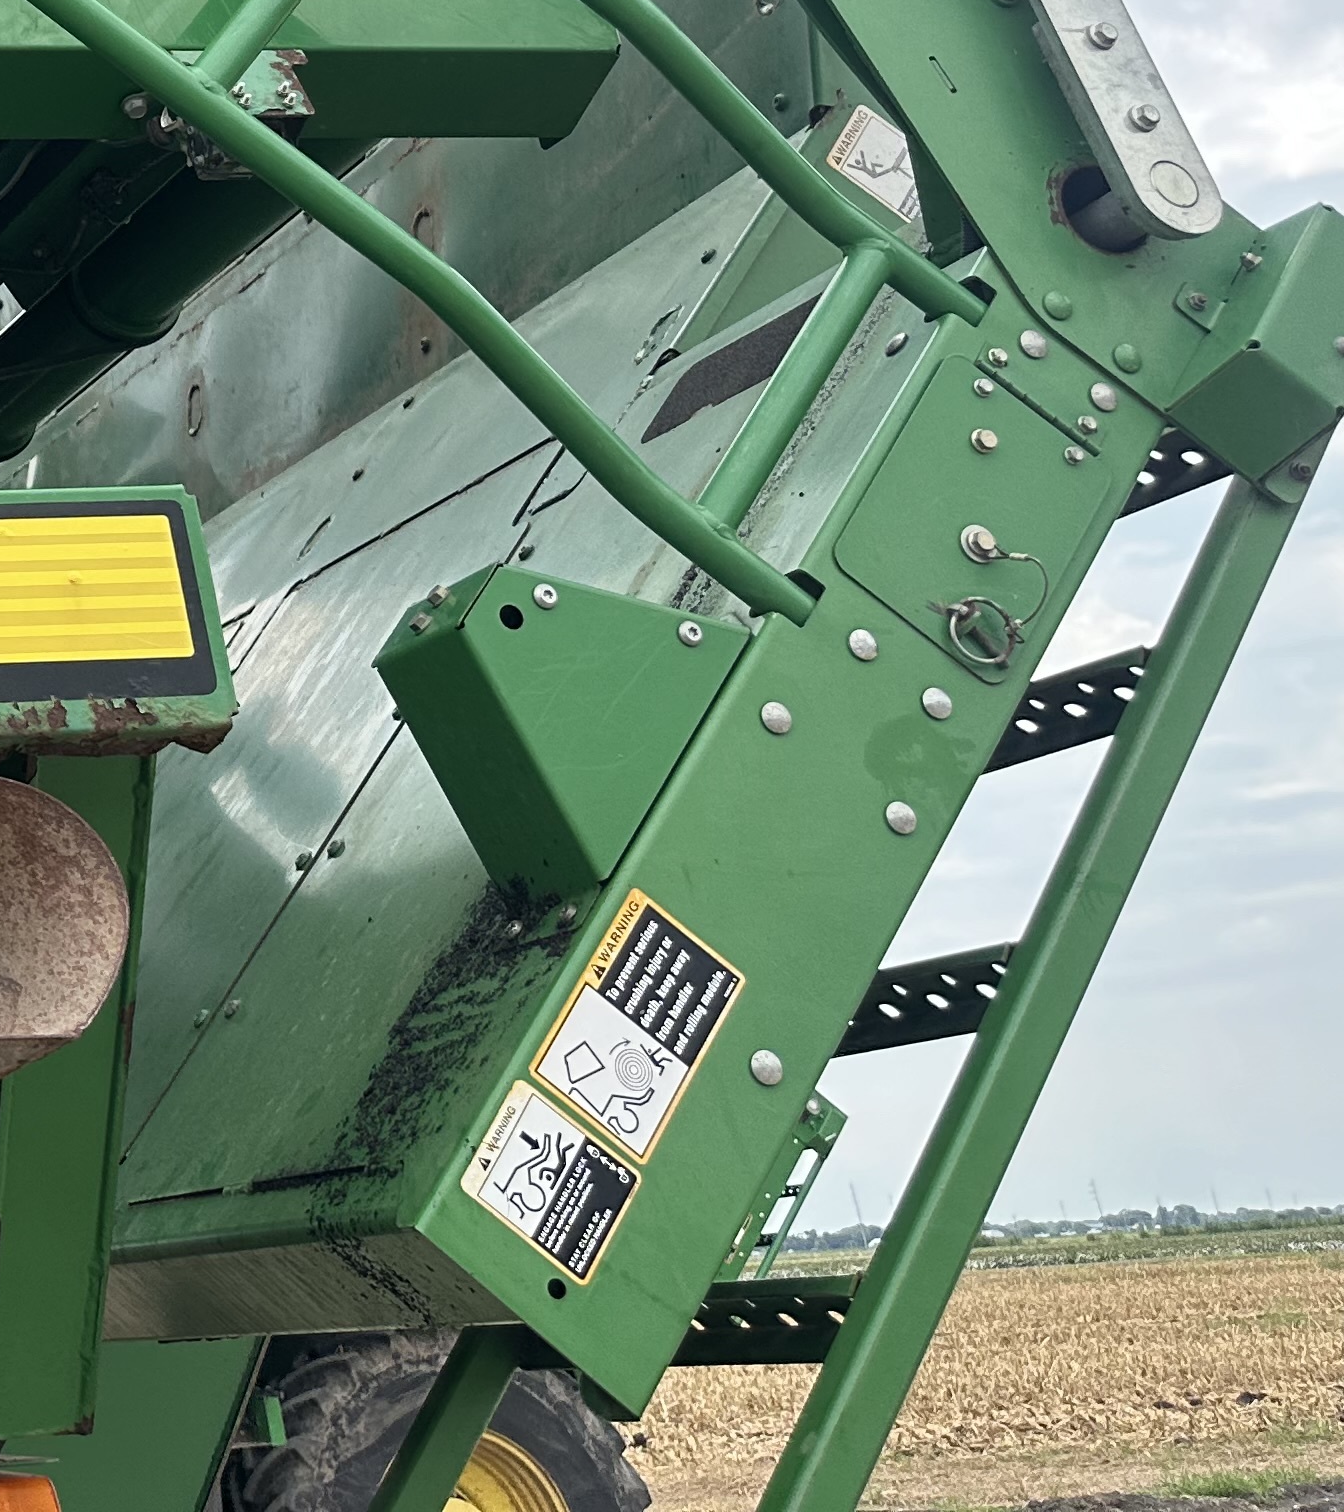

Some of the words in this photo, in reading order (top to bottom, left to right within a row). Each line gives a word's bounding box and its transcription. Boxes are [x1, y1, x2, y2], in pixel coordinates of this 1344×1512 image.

[835, 110, 868, 156] WARNING
[599, 900, 640, 963] WARNING
[607, 987, 620, 1001] To
[614, 952, 641, 991] prevent
[633, 919, 659, 955] serious
[623, 973, 653, 1016] crushing
[645, 946, 669, 977] injury
[661, 936, 674, 949] or
[639, 997, 663, 1029] death,
[656, 973, 677, 999] keep
[670, 949, 692, 977] away
[655, 1016, 675, 1041] from
[668, 981, 695, 1019] handler
[672, 1034, 689, 1055] and
[682, 1004, 708, 1037] rolling
[699, 968, 726, 1006] module.
[487, 1106, 517, 1152] WARNING
[538, 1212, 558, 1242] ENGAGE
[554, 1178, 577, 1212] HANDLER
[573, 1157, 588, 1178] LOCK
[568, 1248, 582, 1268] STAY
[578, 1223, 596, 1249] CLEAR
[591, 1211, 602, 1223] OF
